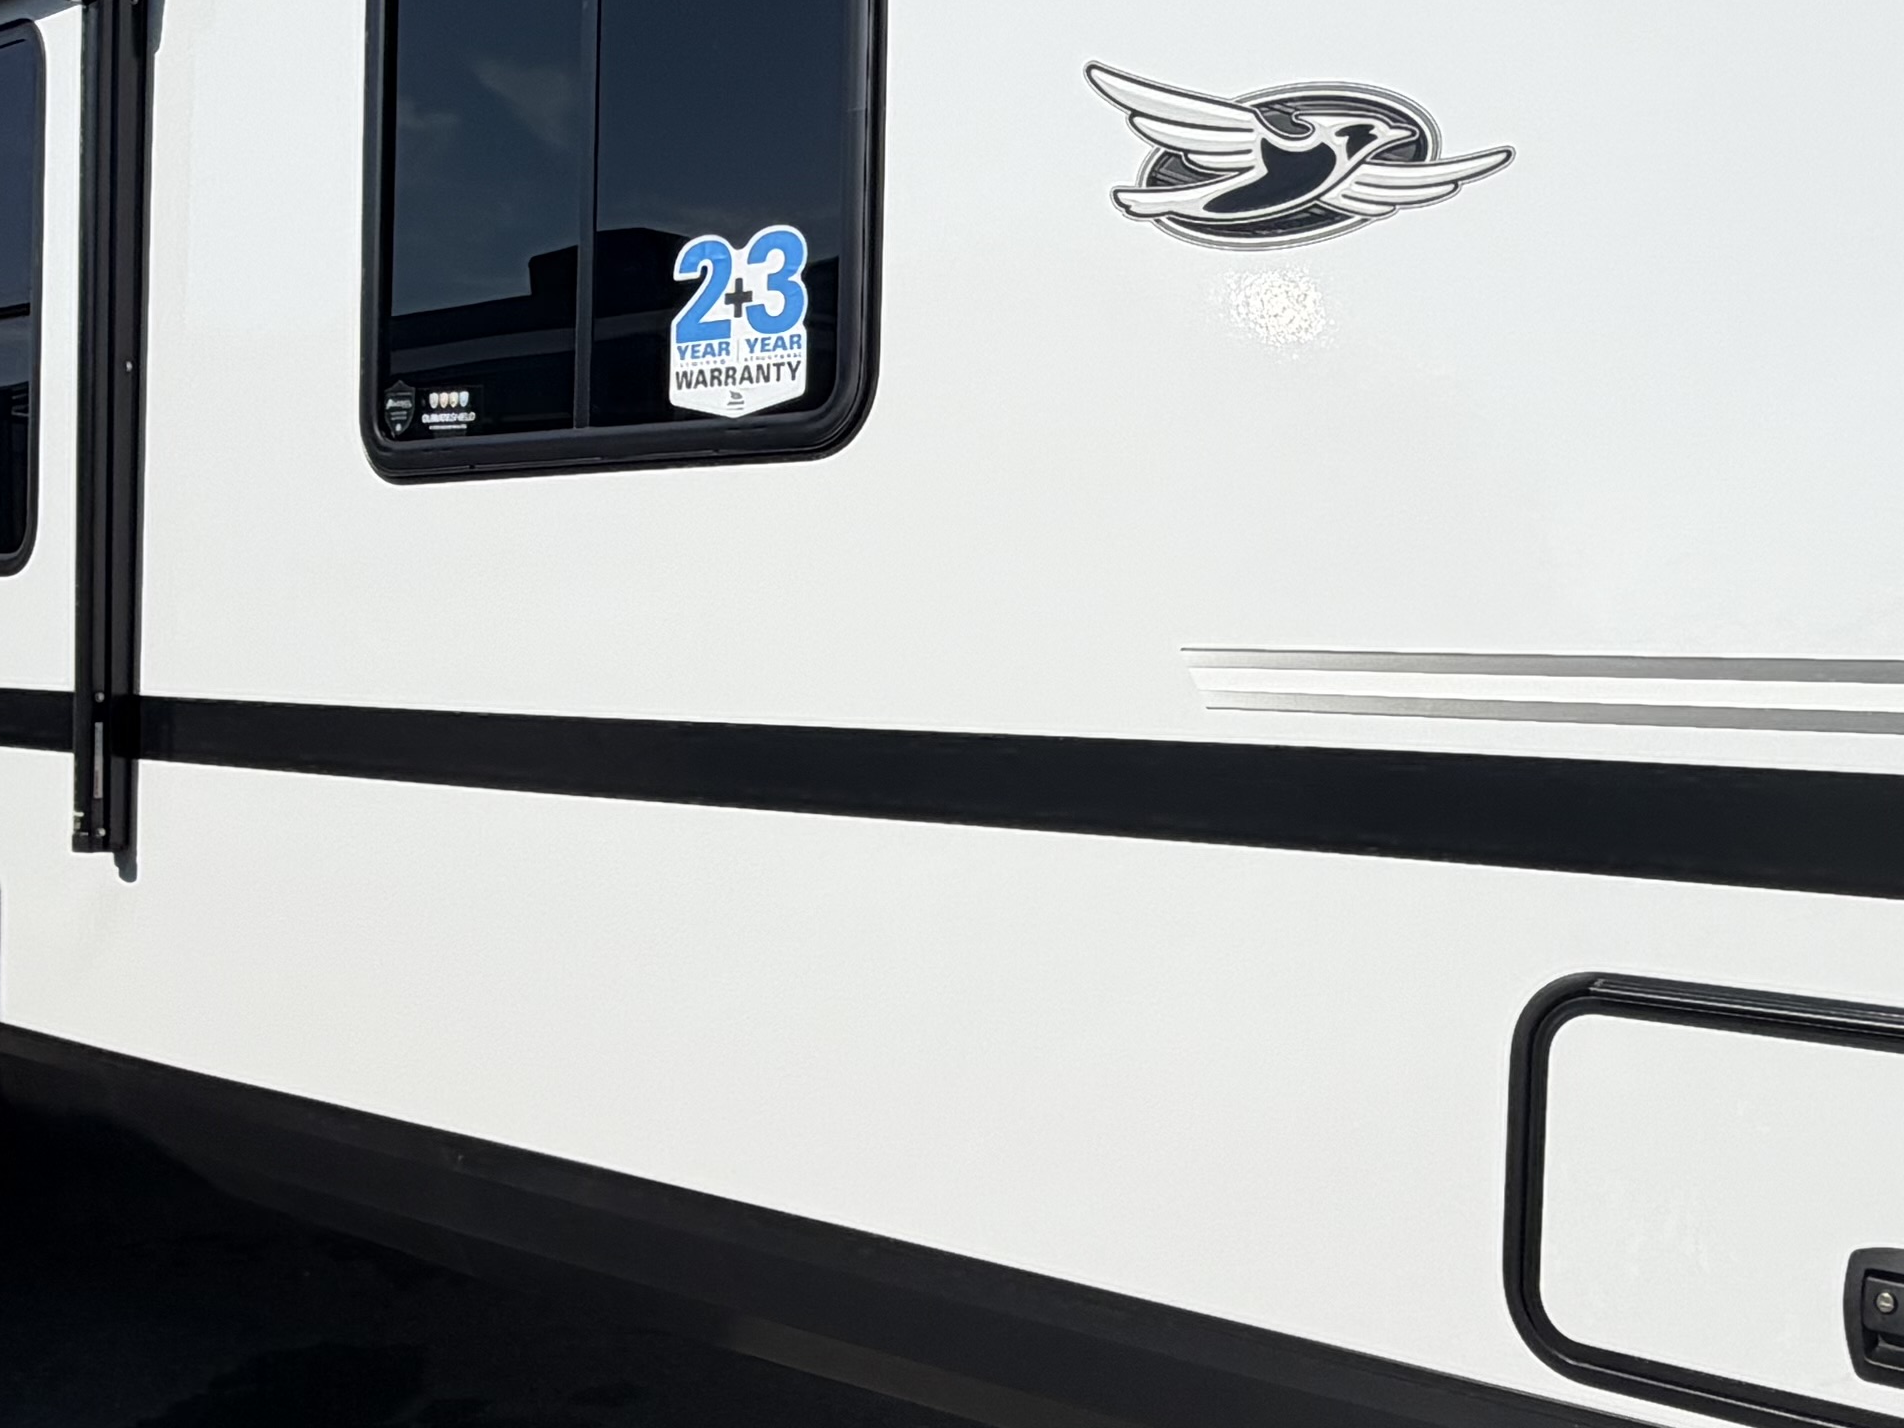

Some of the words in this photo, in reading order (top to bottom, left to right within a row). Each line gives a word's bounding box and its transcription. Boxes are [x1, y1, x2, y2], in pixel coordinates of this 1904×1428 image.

[677, 341, 731, 361] YEAR
[745, 334, 802, 354] YEAR
[675, 360, 802, 390] WARRANTY
